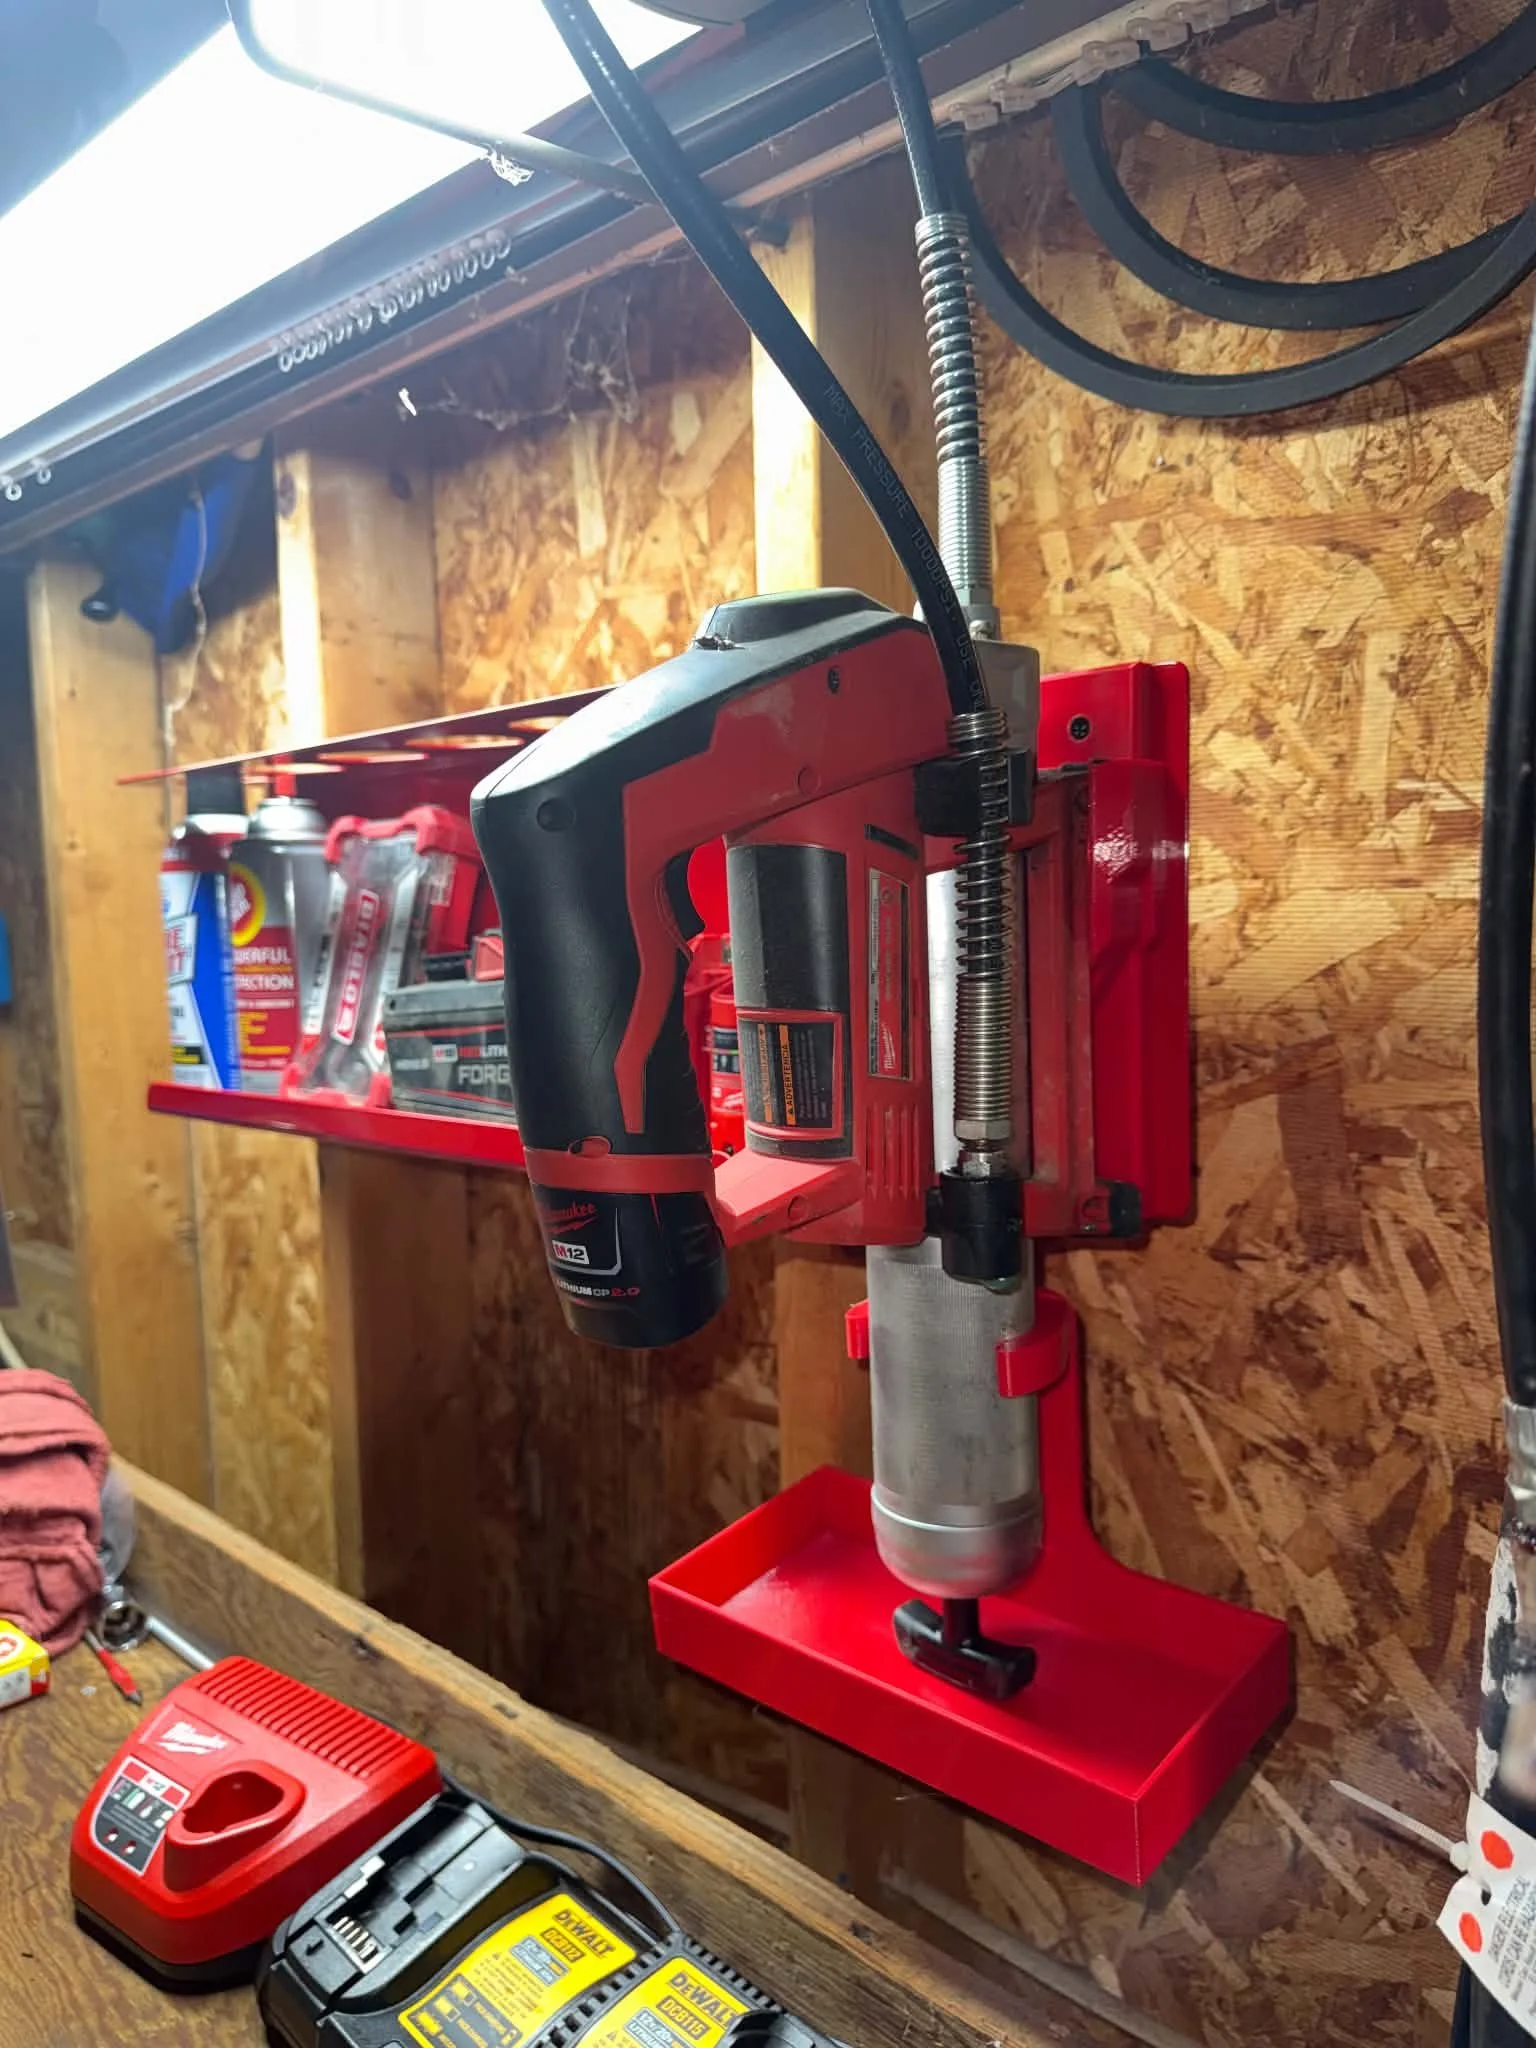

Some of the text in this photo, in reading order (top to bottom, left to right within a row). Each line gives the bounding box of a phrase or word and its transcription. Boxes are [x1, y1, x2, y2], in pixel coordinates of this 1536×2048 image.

[823, 385, 850, 426] MAX
[853, 428, 914, 519] PRESSURE
[458, 1064, 510, 1086] FORG
[553, 1243, 586, 1261] M12
[660, 1998, 707, 2037] DCB115
